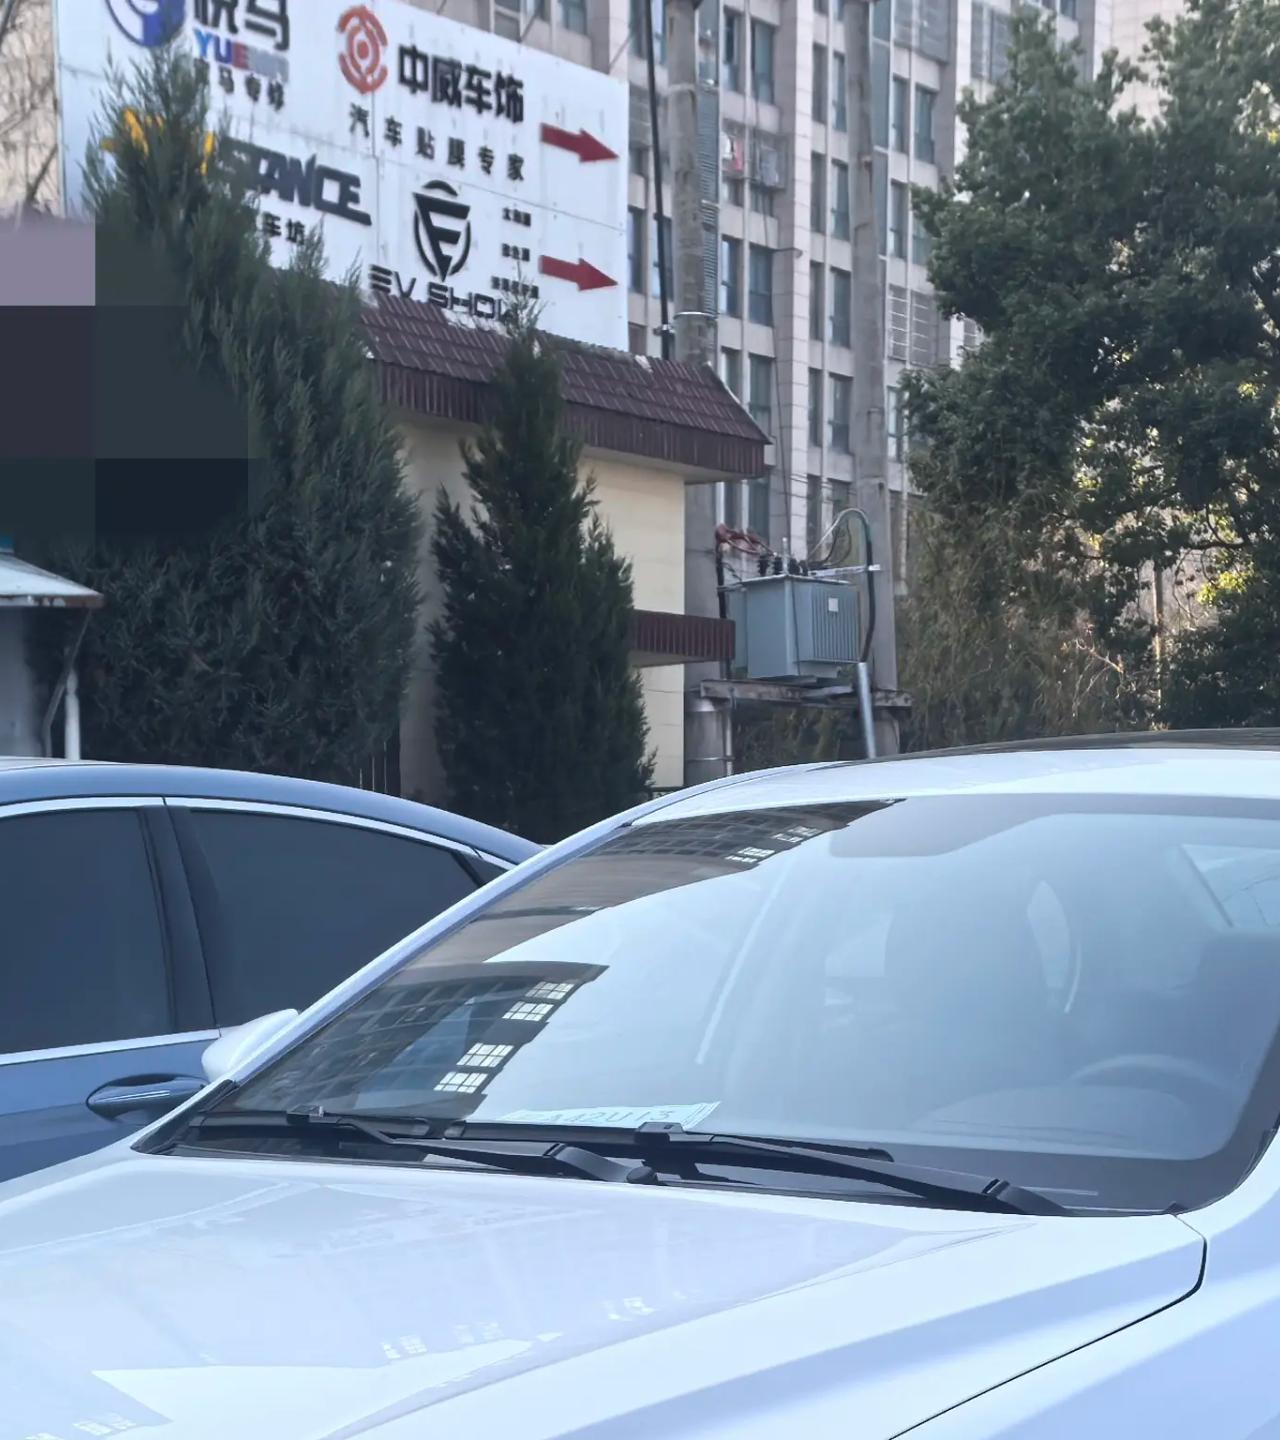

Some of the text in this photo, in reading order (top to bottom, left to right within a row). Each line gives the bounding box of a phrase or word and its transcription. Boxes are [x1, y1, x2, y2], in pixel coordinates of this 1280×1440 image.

[398, 44, 525, 124] 中威车饰
[349, 102, 525, 182] 汽车贴膜专家
